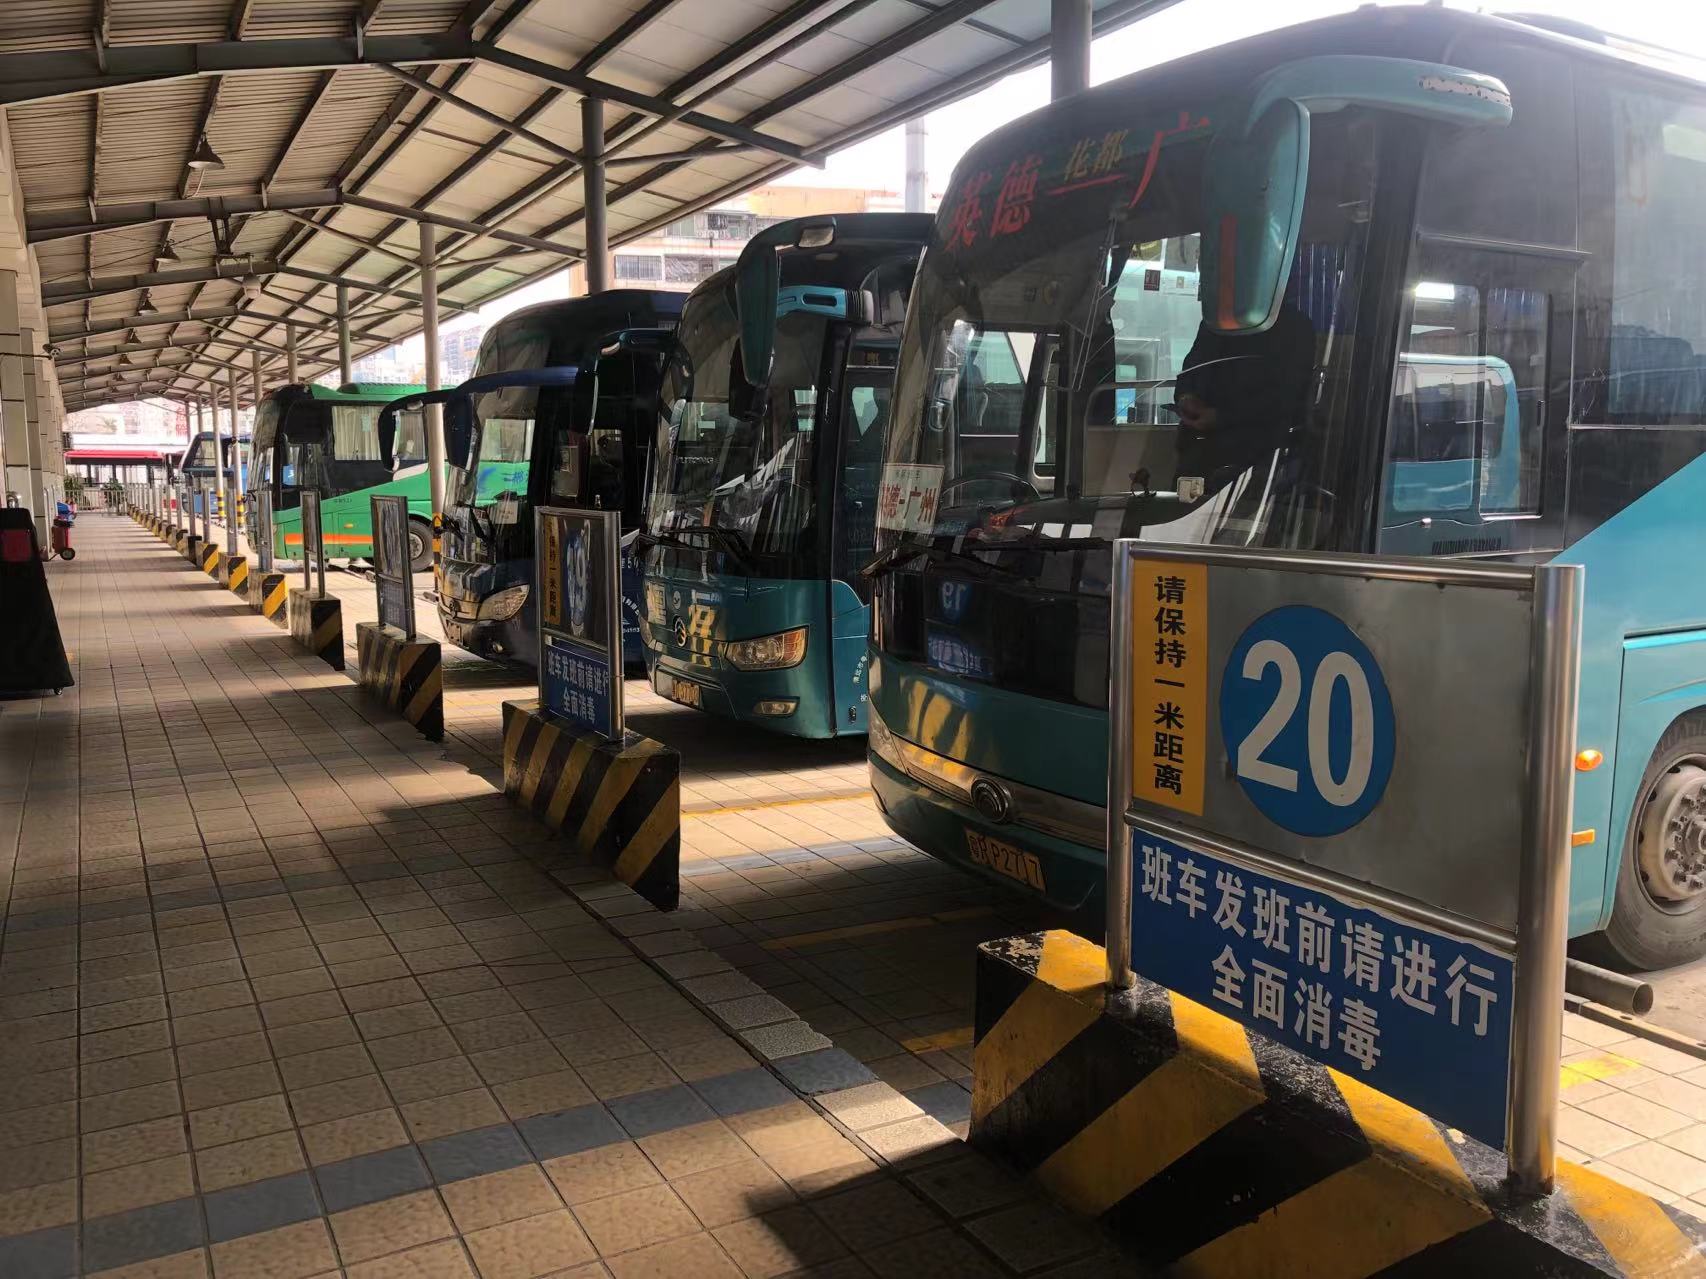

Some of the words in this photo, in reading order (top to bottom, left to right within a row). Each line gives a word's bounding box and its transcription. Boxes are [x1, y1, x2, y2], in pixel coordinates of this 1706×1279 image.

[944, 155, 1042, 252] 英德
[547, 650, 609, 697] 班车发班前请进行
[563, 686, 596, 725] 全面消毒
[1153, 575, 1187, 796] 请保持一米距离
[1236, 638, 1375, 807] 20
[1141, 844, 1498, 1036] 班车发班前请进行
[1211, 943, 1381, 1071] 全面消毒
